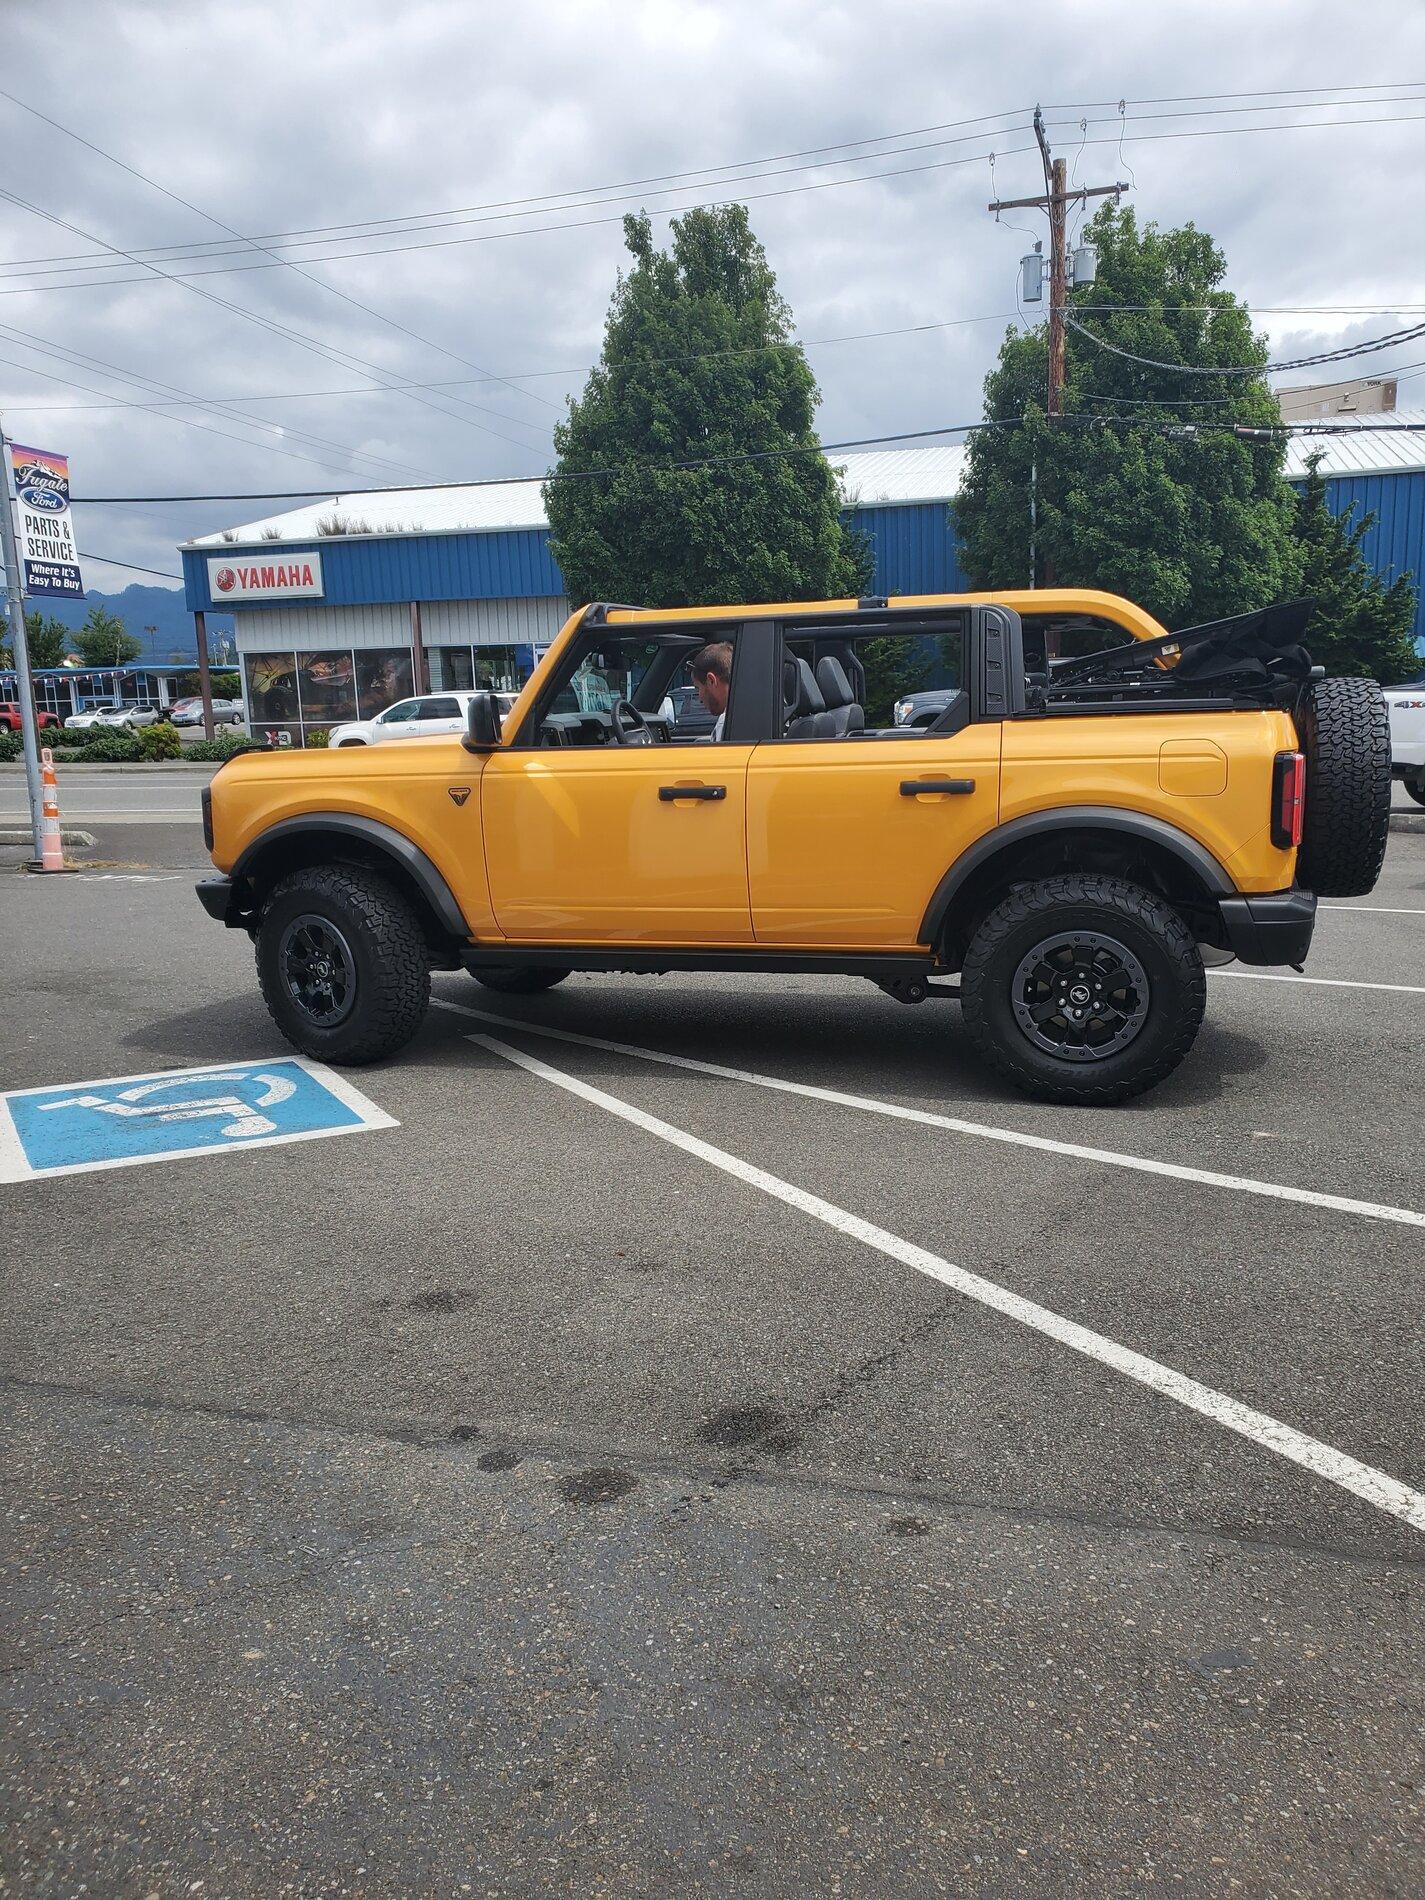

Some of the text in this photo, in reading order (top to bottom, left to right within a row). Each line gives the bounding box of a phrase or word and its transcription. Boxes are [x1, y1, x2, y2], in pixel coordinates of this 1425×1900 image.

[15, 463, 68, 492] Fugate
[31, 491, 57, 508] Ford
[25, 514, 71, 540] PARTS &
[27, 537, 75, 562] SERVICE
[31, 563, 76, 578] Where It's
[236, 564, 315, 590] YAMAHA
[28, 574, 80, 591] Easy To Buy
[1394, 700, 1425, 709] 4X
